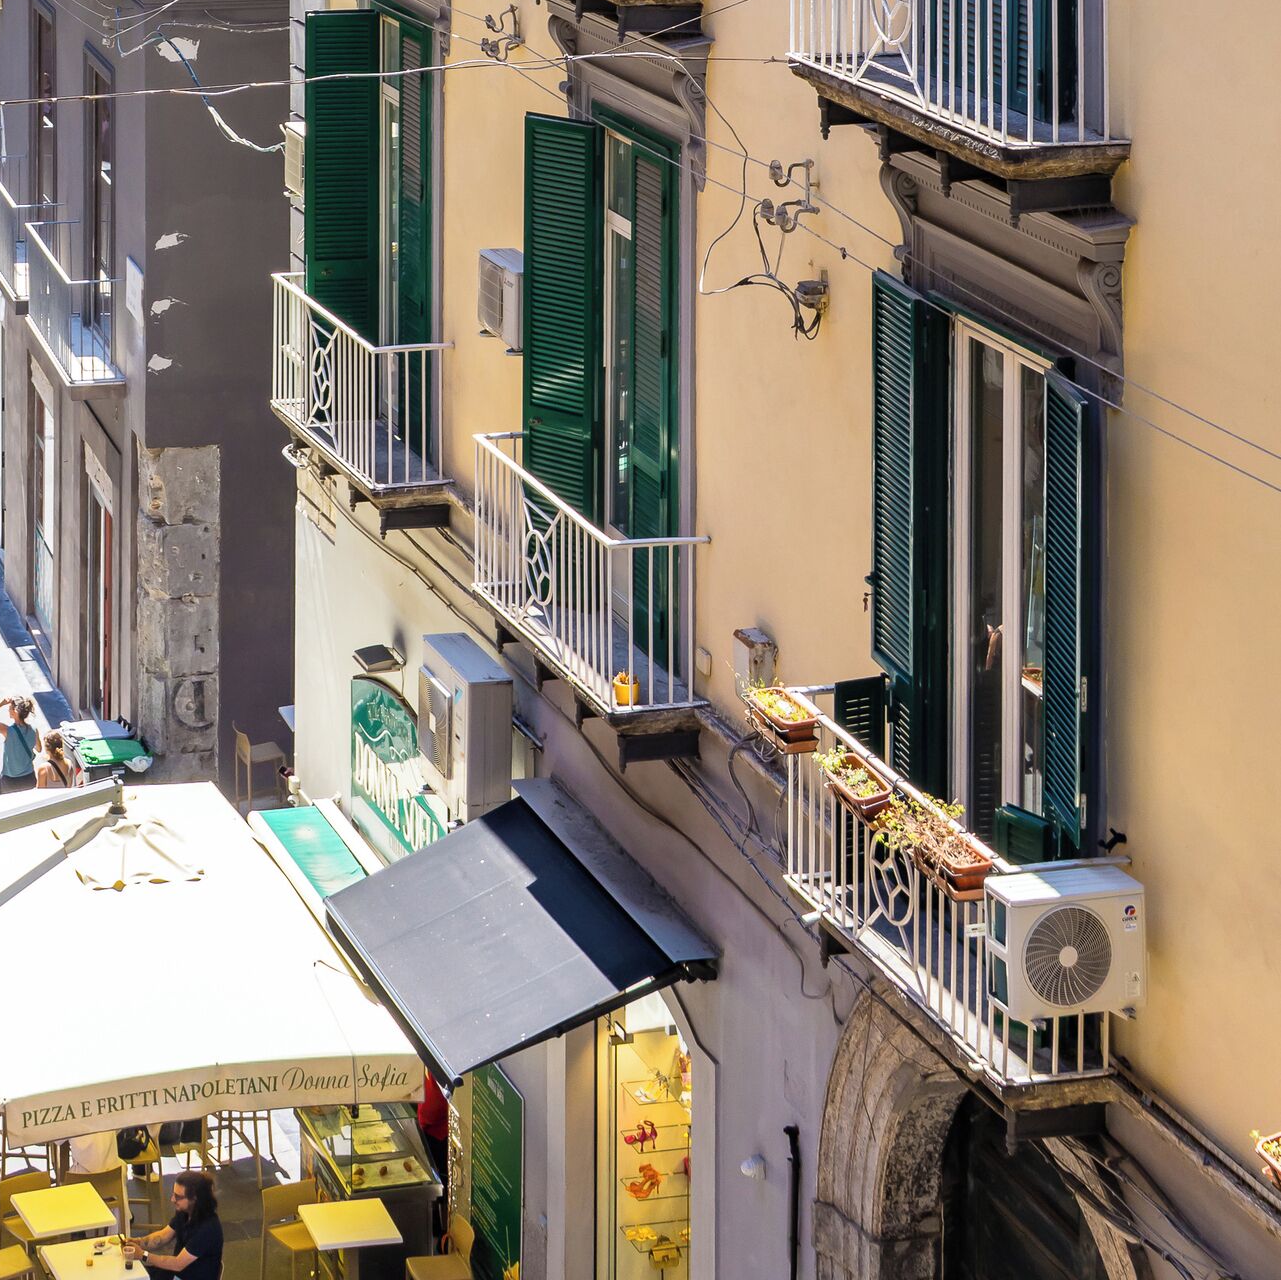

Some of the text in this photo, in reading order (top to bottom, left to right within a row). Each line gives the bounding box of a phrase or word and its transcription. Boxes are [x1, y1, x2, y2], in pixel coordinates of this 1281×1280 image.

[355, 731, 400, 831] DONNA
[22, 1063, 409, 1128] PIZZA E FRITTI NAPOLETANI Donna Sofia
